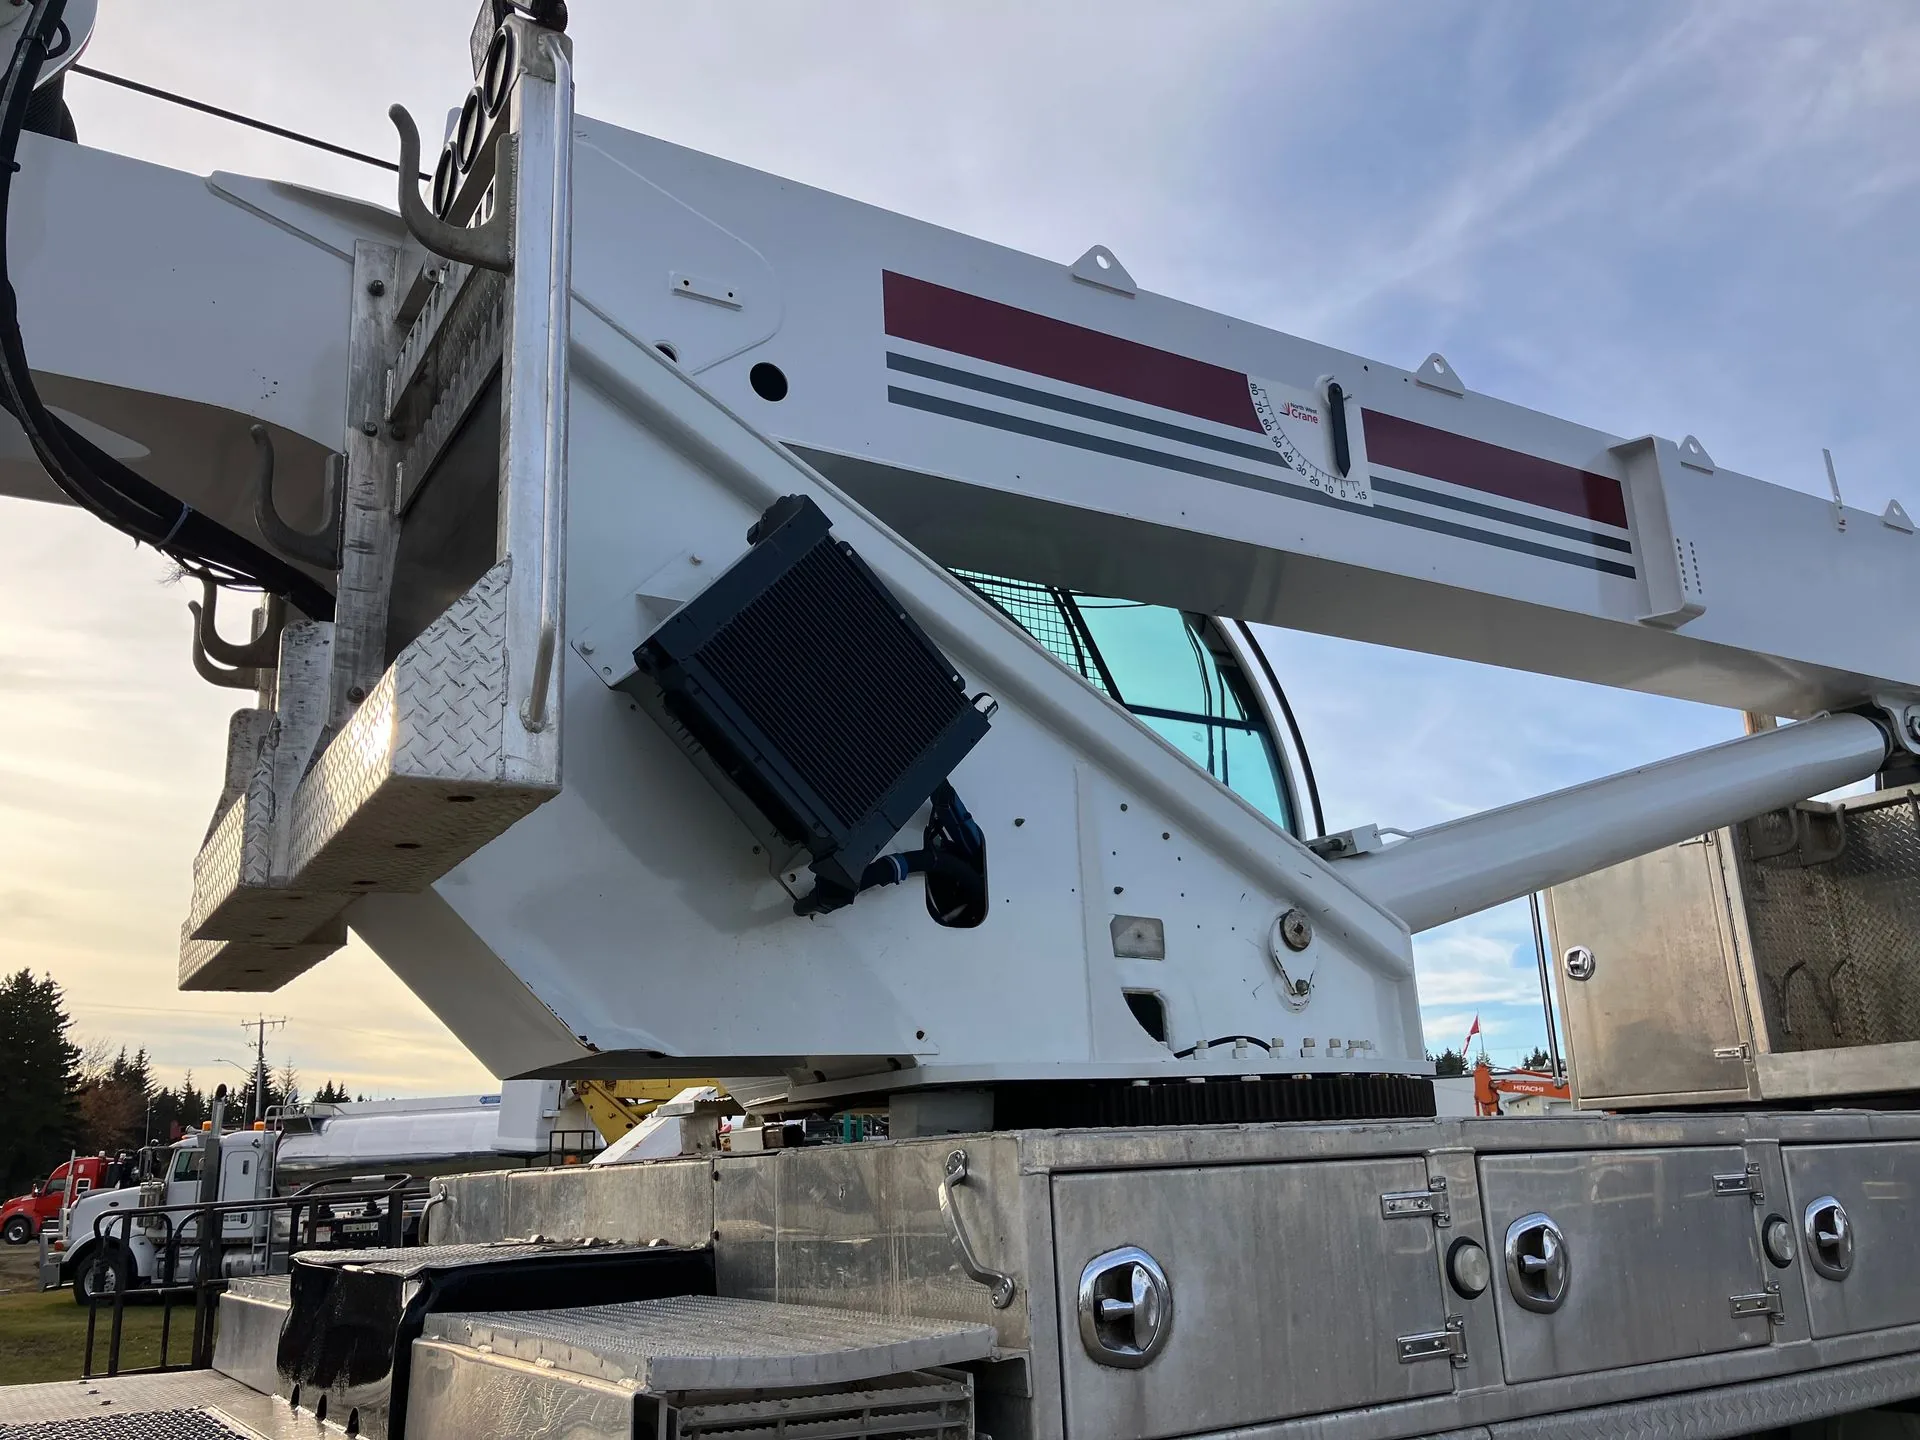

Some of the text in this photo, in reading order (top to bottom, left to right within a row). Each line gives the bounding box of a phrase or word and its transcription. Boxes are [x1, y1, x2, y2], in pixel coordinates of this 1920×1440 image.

[1291, 409, 1319, 424] Crane
[1262, 419, 1272, 431] 60
[1272, 436, 1282, 448] 50
[1283, 452, 1293, 463] 40
[1296, 464, 1307, 476] 30
[1309, 476, 1320, 487] 20
[1324, 484, 1334, 494] 10
